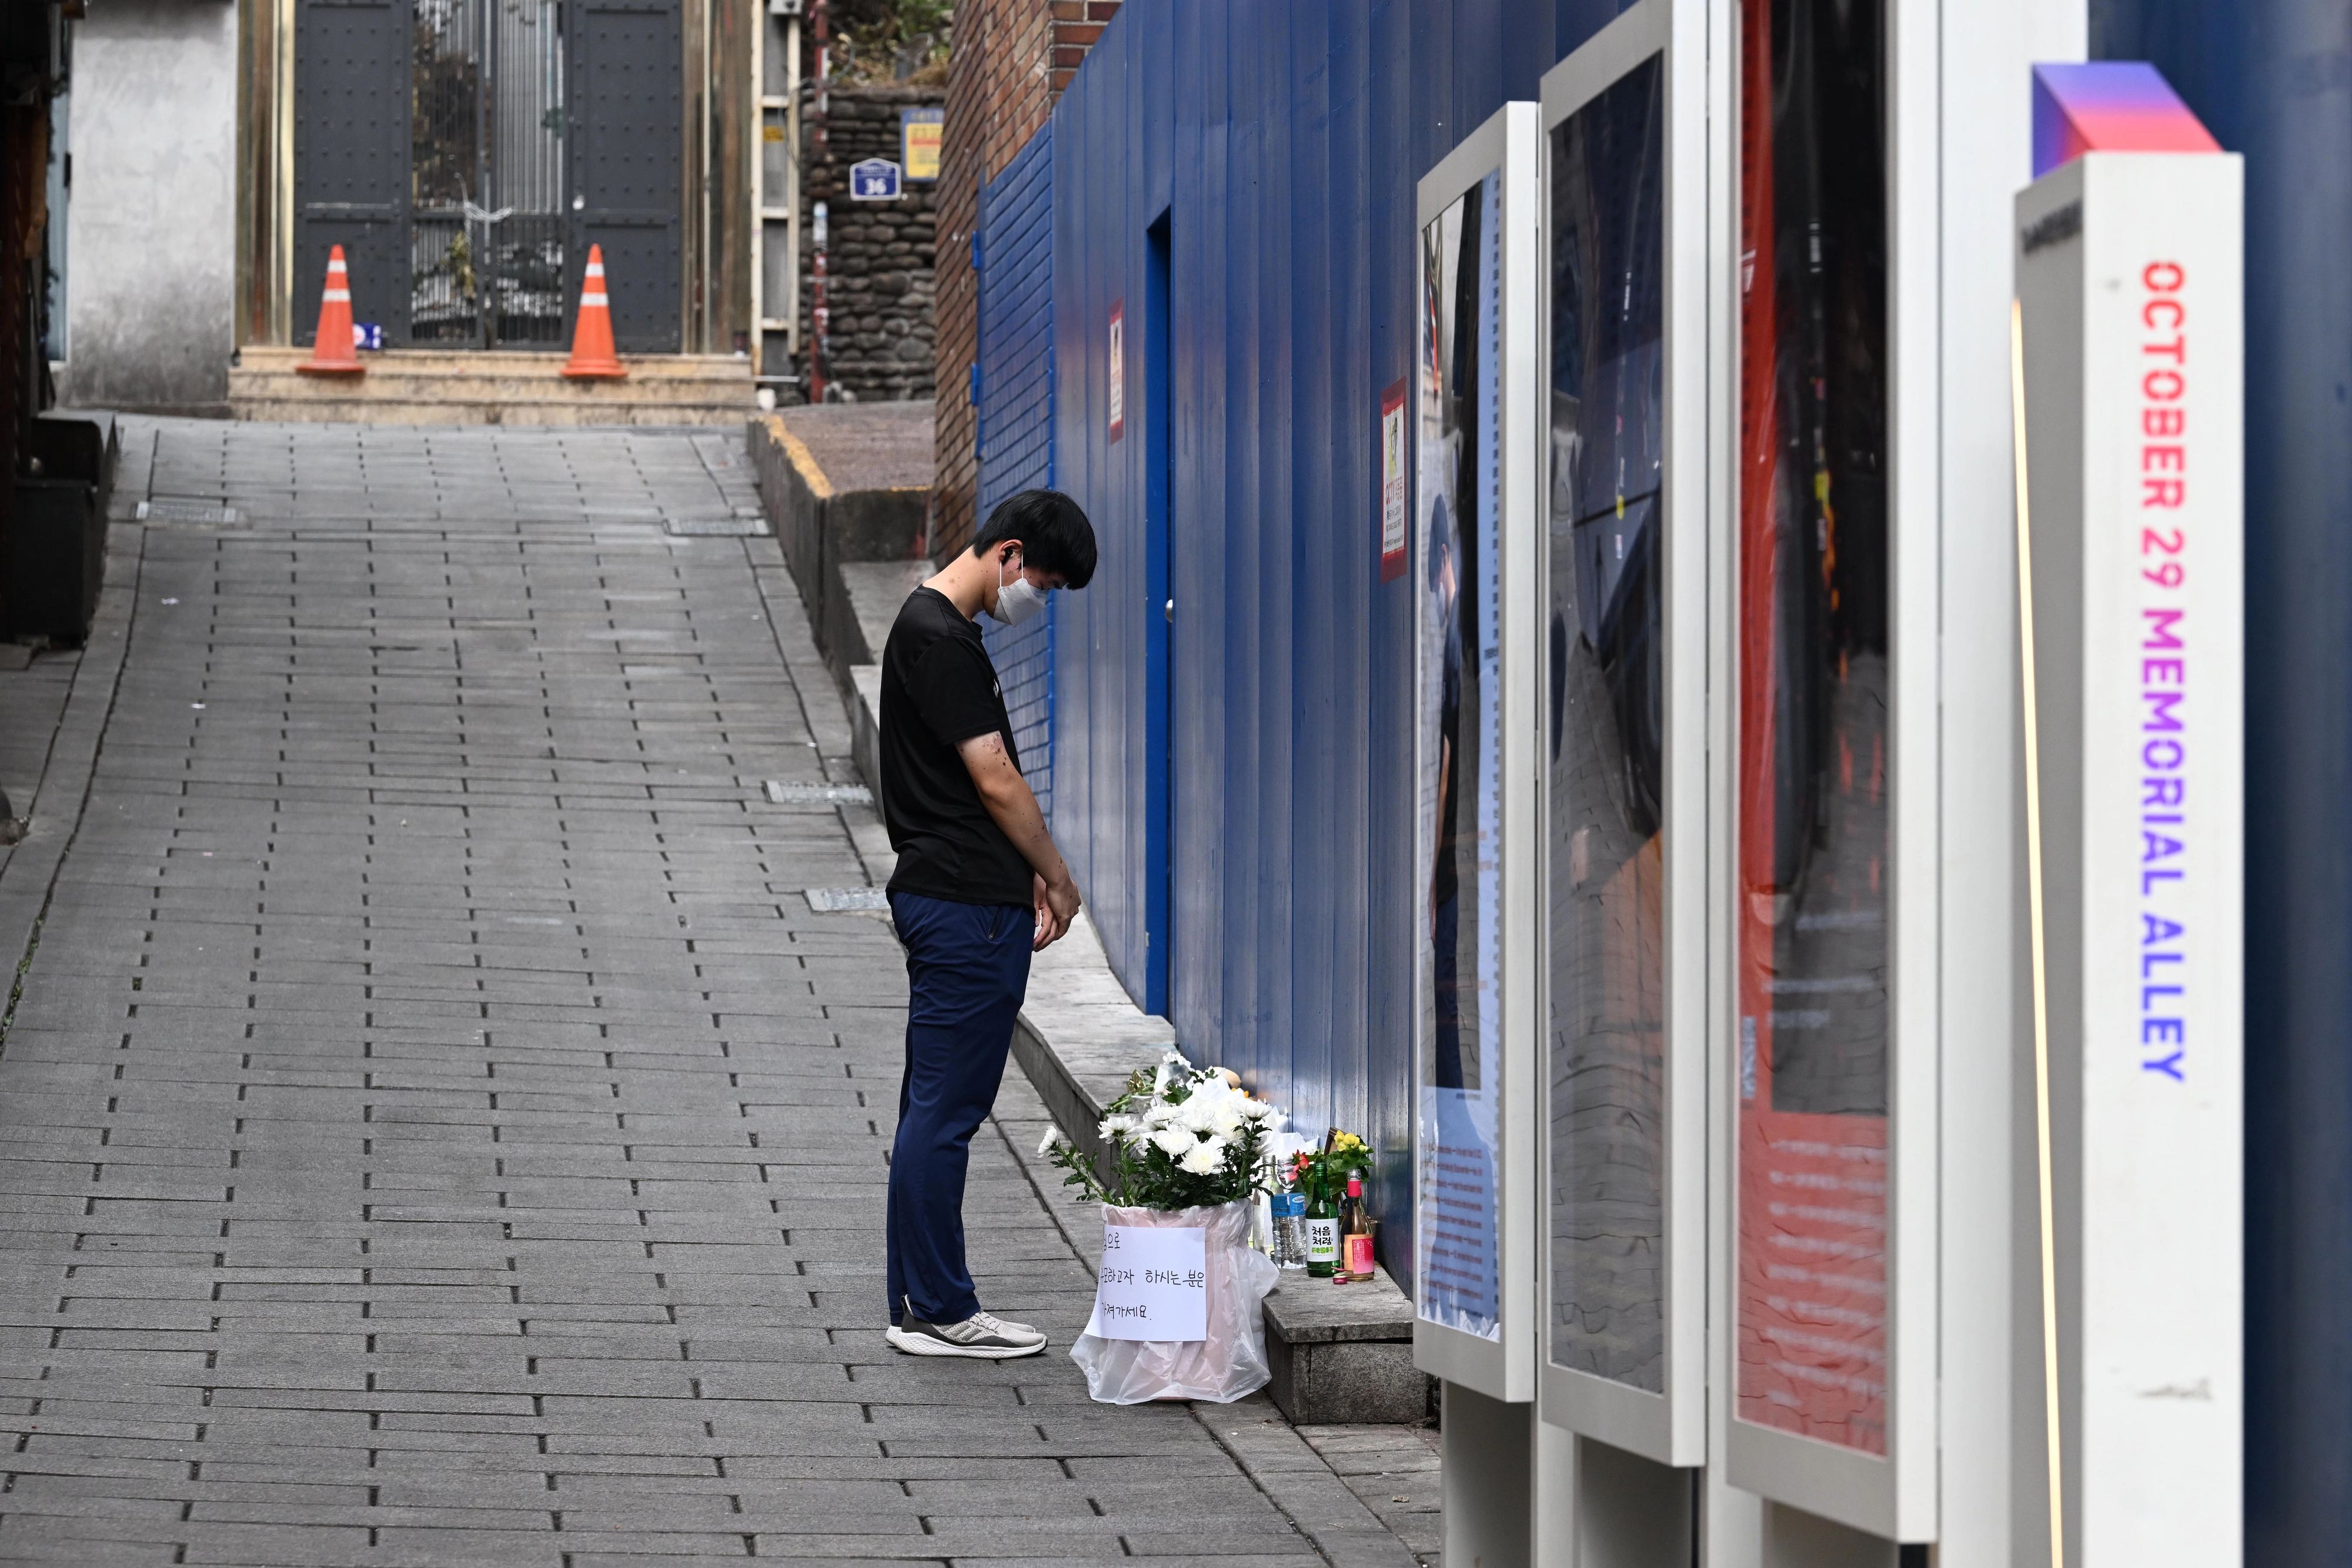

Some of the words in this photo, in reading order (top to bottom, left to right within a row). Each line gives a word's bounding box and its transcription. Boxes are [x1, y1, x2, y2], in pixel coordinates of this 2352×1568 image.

[2142, 262, 2185, 508] OCTOBER
[2142, 528, 2184, 587] 29
[2142, 609, 2184, 896] MEMORIAL
[2141, 913, 2184, 1081] ALLEY
[1312, 1226, 1331, 1236] 처음
[1312, 1236, 1332, 1246] 처럼
[1145, 1269, 1181, 1285] 하시는
[1182, 1269, 1204, 1288] 분은
[1102, 1301, 1152, 1320] 가져가세요.
